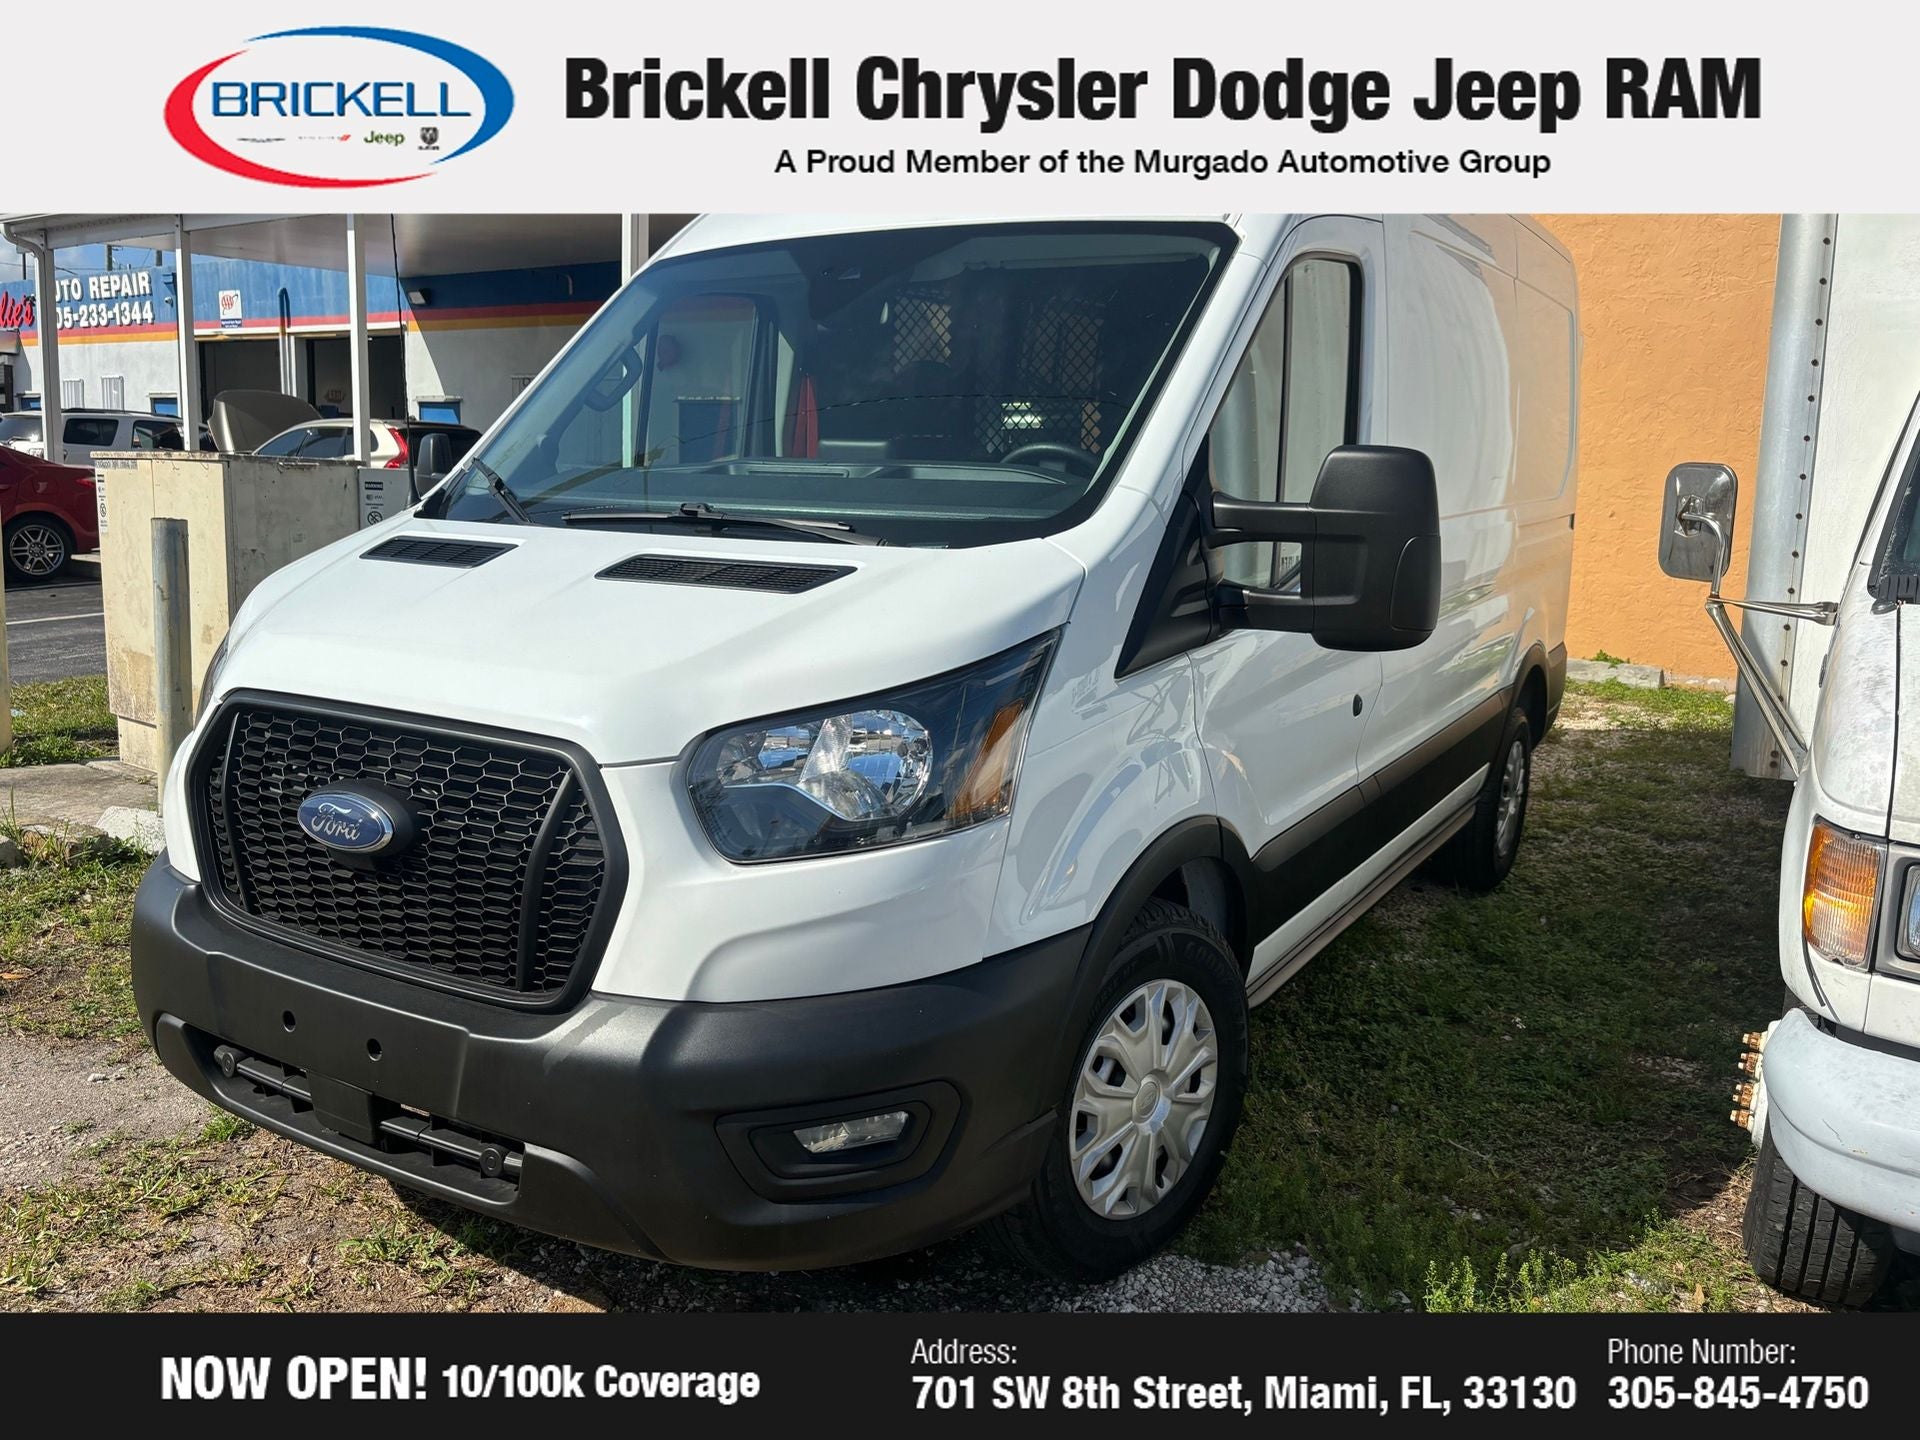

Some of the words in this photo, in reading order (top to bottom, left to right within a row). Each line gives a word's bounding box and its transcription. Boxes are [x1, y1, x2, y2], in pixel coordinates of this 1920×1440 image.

[89, 271, 151, 299] REPAIR
[56, 301, 154, 330] 05-233-1344
[311, 802, 362, 840] Ford
